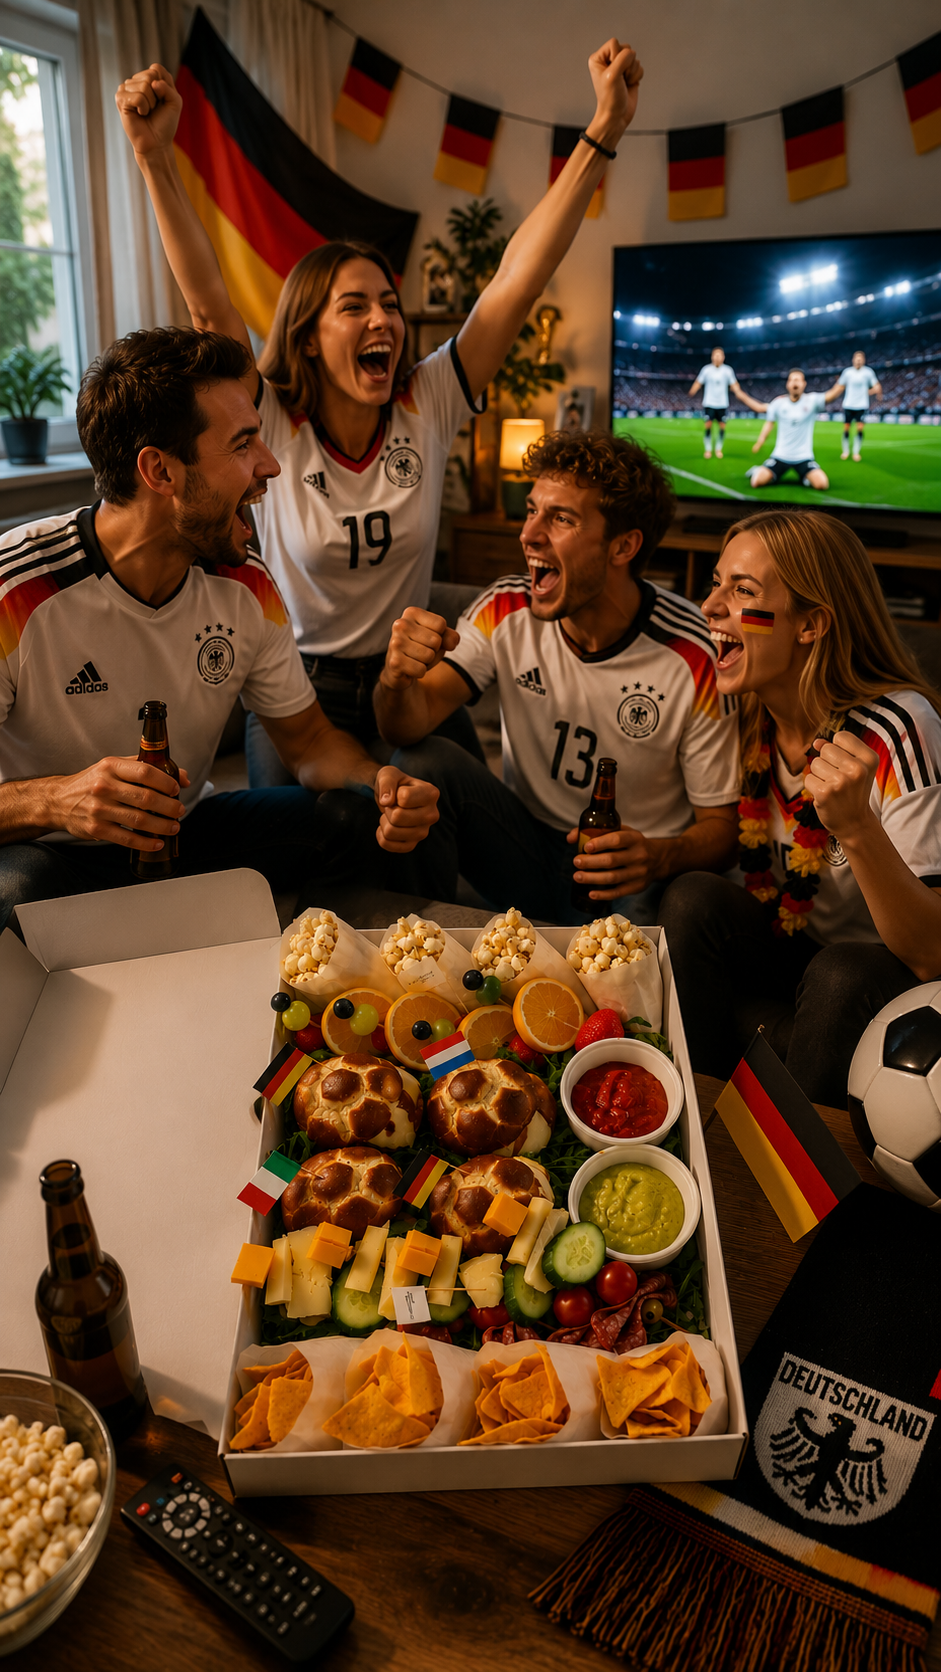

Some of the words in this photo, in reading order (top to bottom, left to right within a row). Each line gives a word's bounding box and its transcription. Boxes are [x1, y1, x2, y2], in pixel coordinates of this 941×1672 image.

[342, 510, 392, 570] 19
[65, 682, 109, 696] adidas
[550, 720, 597, 789] 13
[778, 1359, 928, 1442] DEUTSCHLAND
